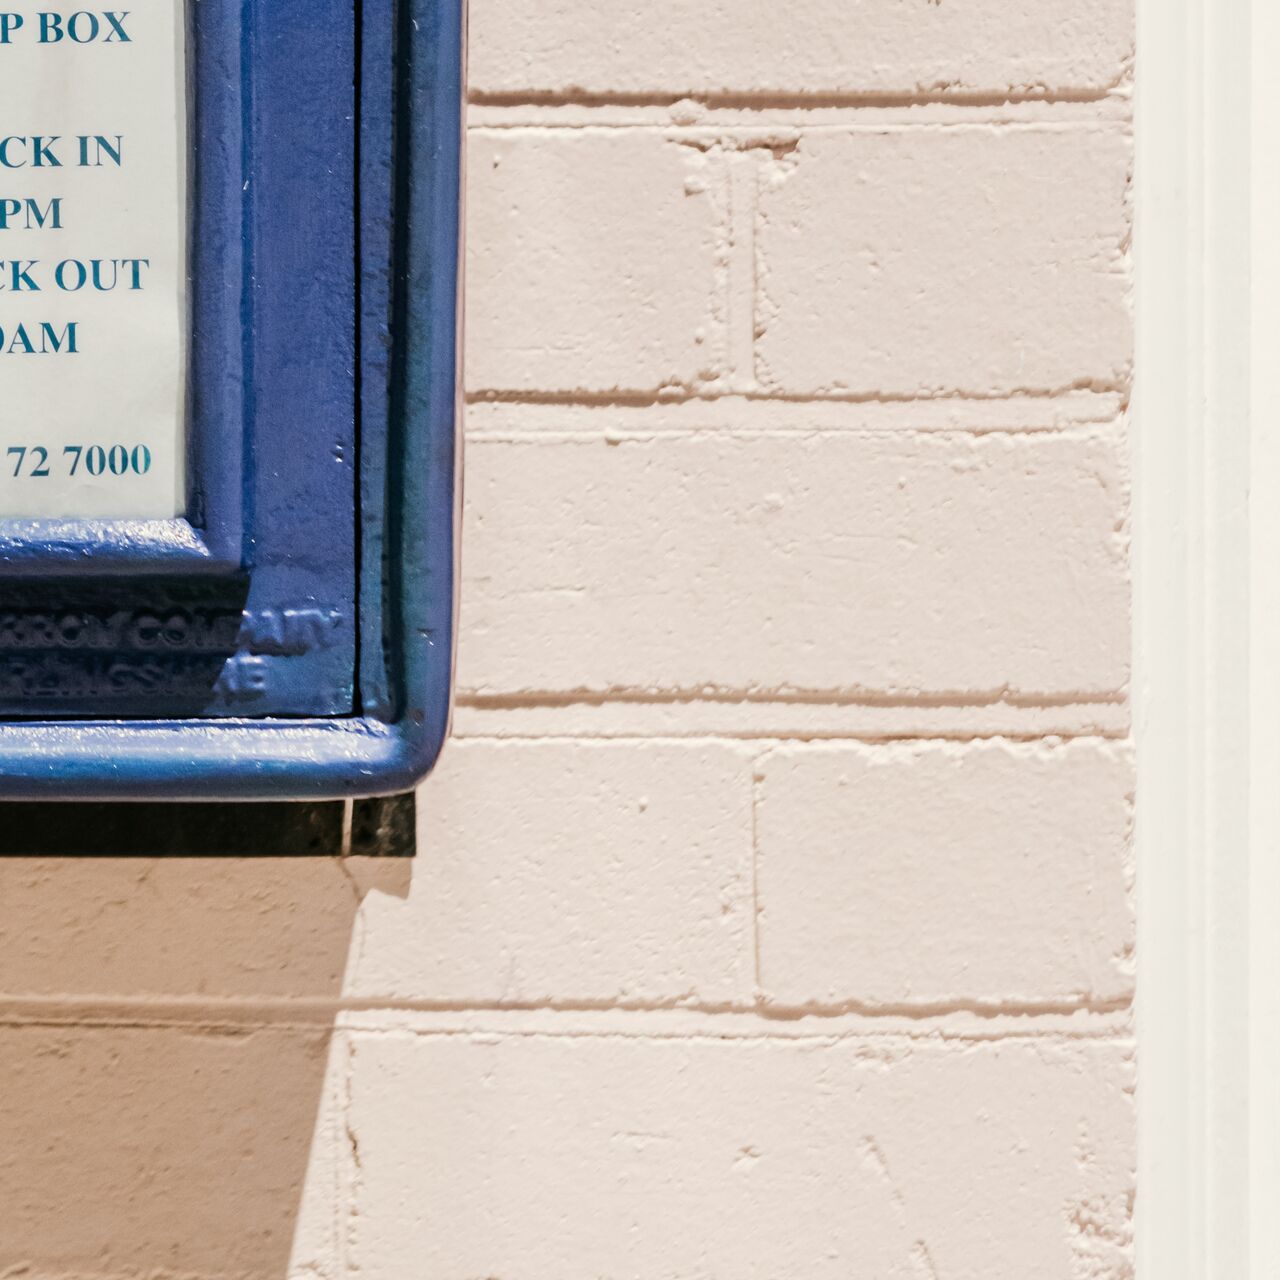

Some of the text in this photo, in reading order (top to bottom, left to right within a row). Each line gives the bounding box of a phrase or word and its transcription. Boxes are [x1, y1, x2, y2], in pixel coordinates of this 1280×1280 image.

[37, 11, 133, 44] BOX
[76, 135, 124, 167] IN
[54, 259, 150, 292] OUT
[6, 446, 50, 478] 72
[62, 444, 151, 476] 7000
